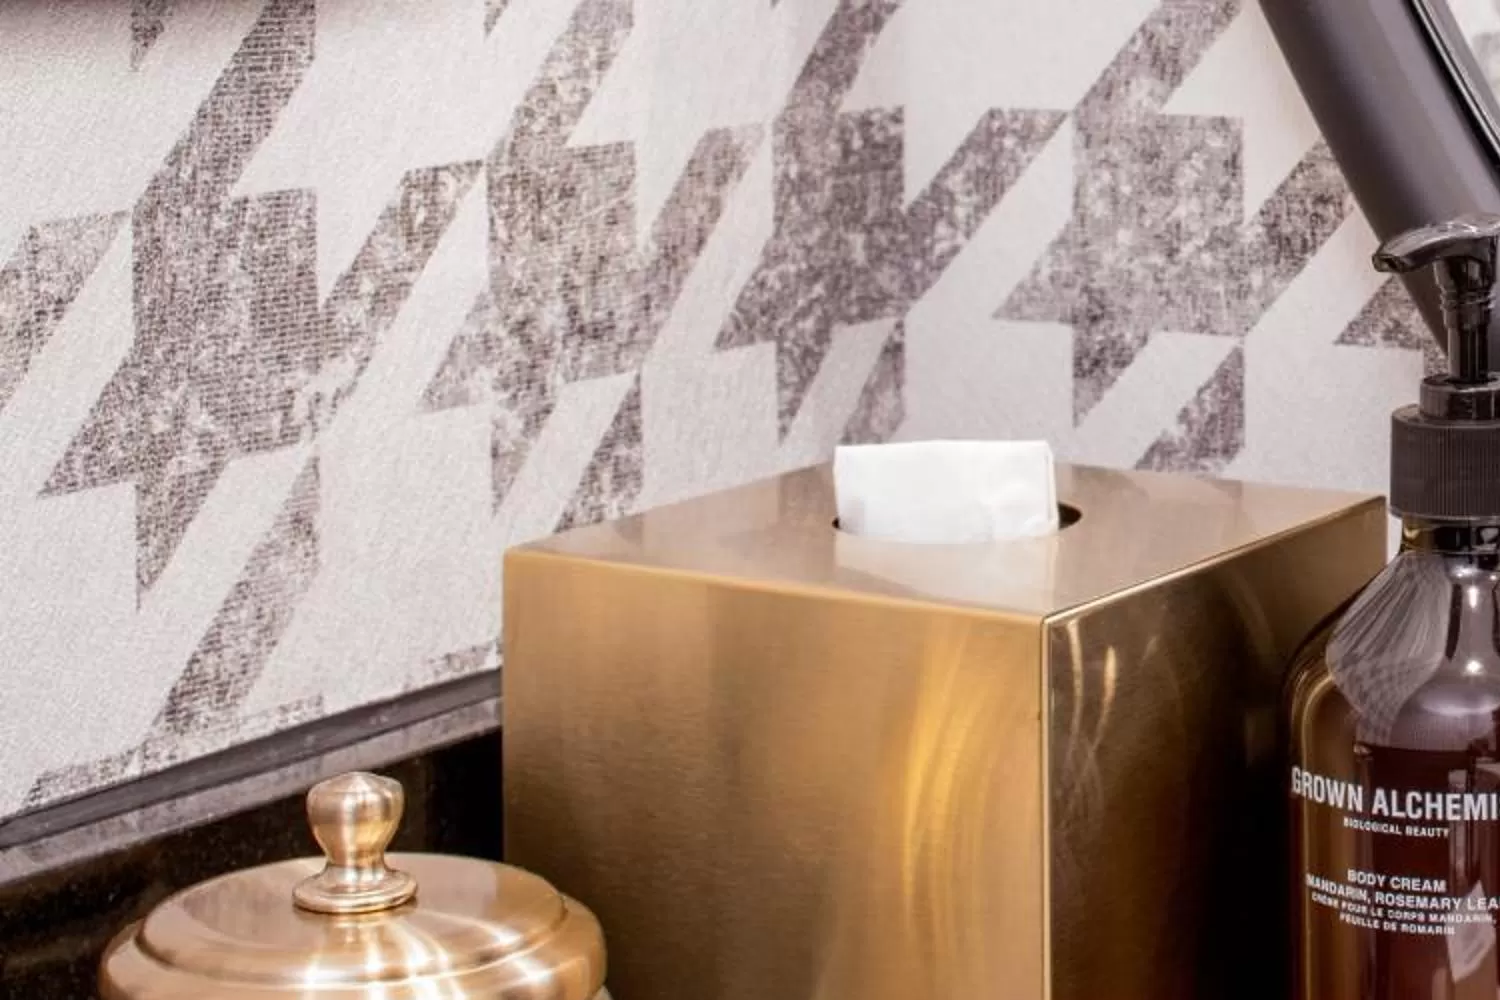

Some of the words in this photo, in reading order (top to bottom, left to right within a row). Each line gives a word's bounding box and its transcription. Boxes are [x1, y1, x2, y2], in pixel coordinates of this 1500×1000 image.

[1292, 766, 1362, 813] GROWN
[1344, 817, 1401, 835] BIOLOGICAL
[1405, 826, 1449, 838] BEAUTY
[1347, 869, 1387, 888] BODY
[1390, 875, 1446, 893] CREAM
[1375, 892, 1461, 910] ROSEMARY
[1370, 906, 1383, 917] LE
[1383, 920, 1397, 931] DE
